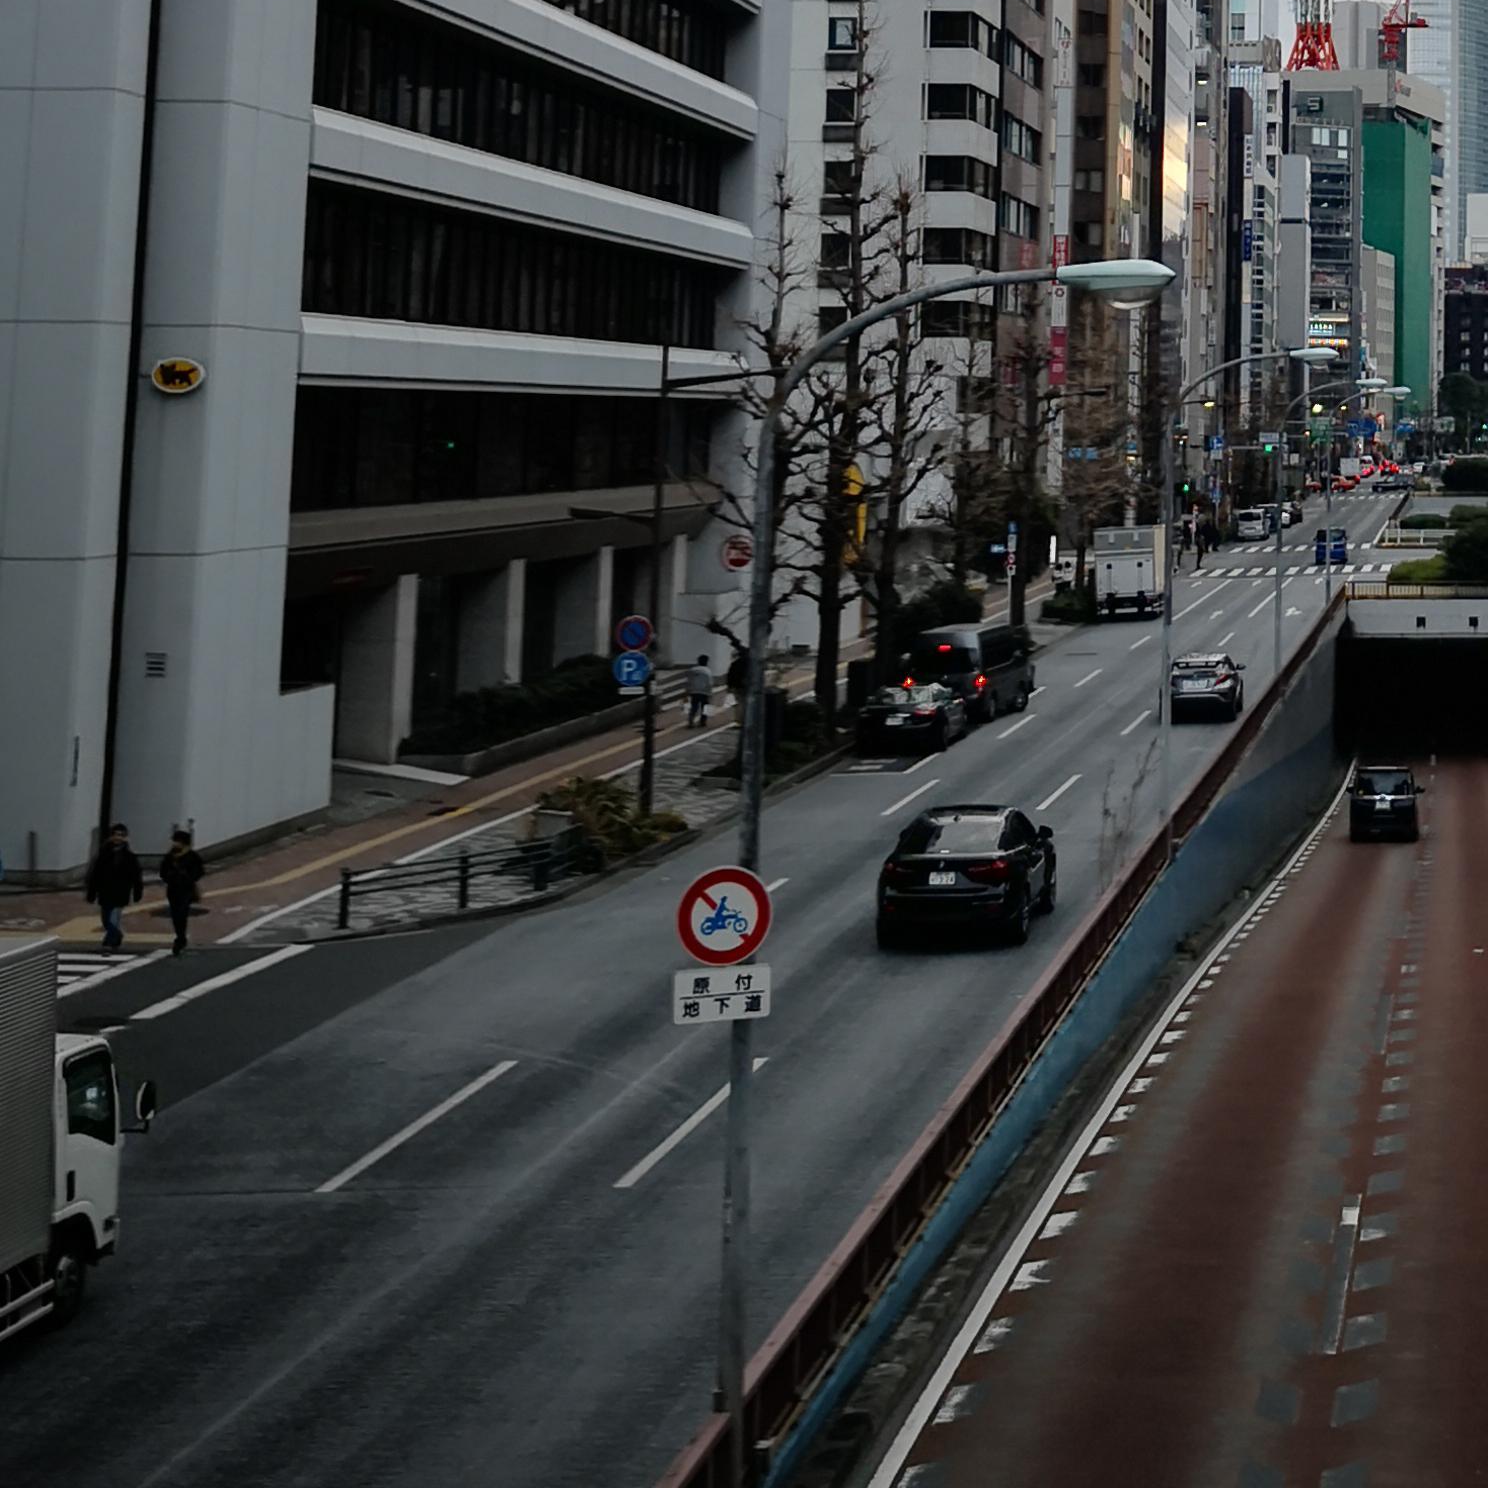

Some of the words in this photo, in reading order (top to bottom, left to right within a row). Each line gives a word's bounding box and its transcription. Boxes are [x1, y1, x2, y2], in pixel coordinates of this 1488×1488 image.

[692, 975, 753, 994] 原付
[682, 995, 762, 1018] 地下道
